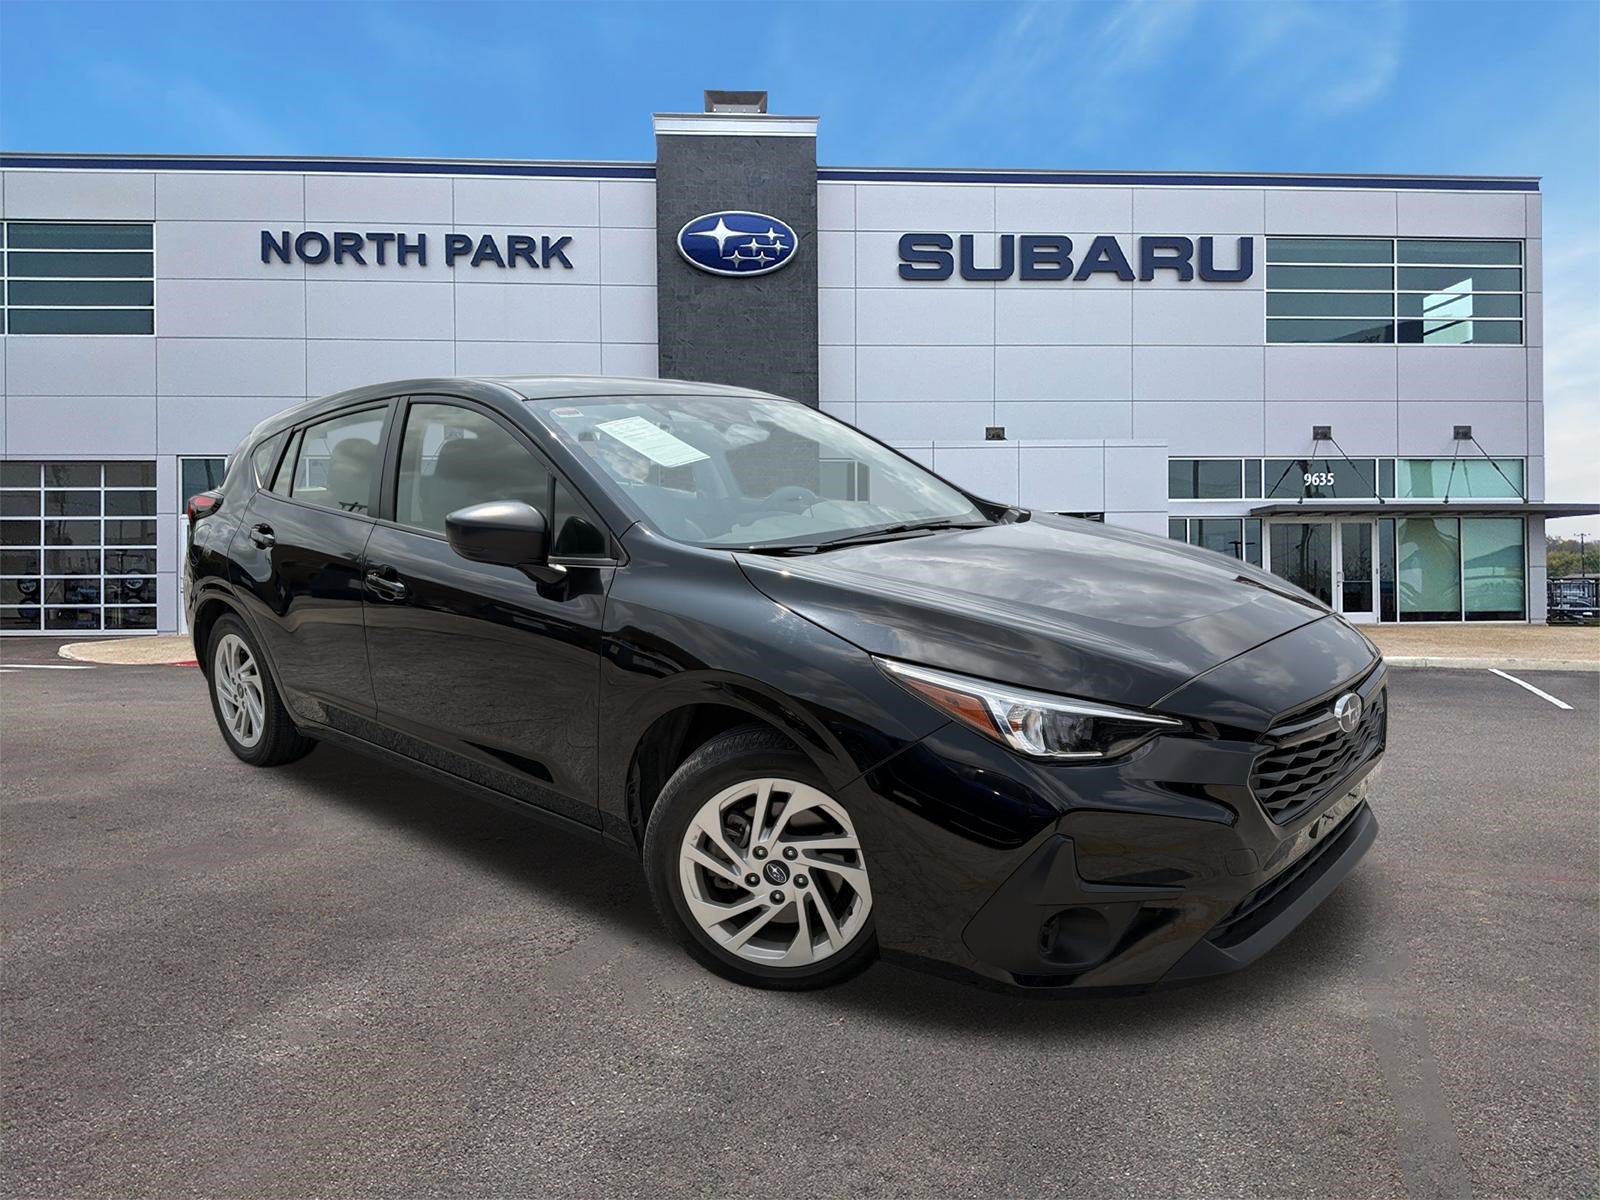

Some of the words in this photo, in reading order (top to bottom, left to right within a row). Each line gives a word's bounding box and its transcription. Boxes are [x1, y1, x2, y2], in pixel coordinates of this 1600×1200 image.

[260, 230, 427, 267] NORTH
[445, 233, 574, 270] PARK
[898, 233, 1254, 282] SUBARU
[1304, 472, 1334, 486] 9635
